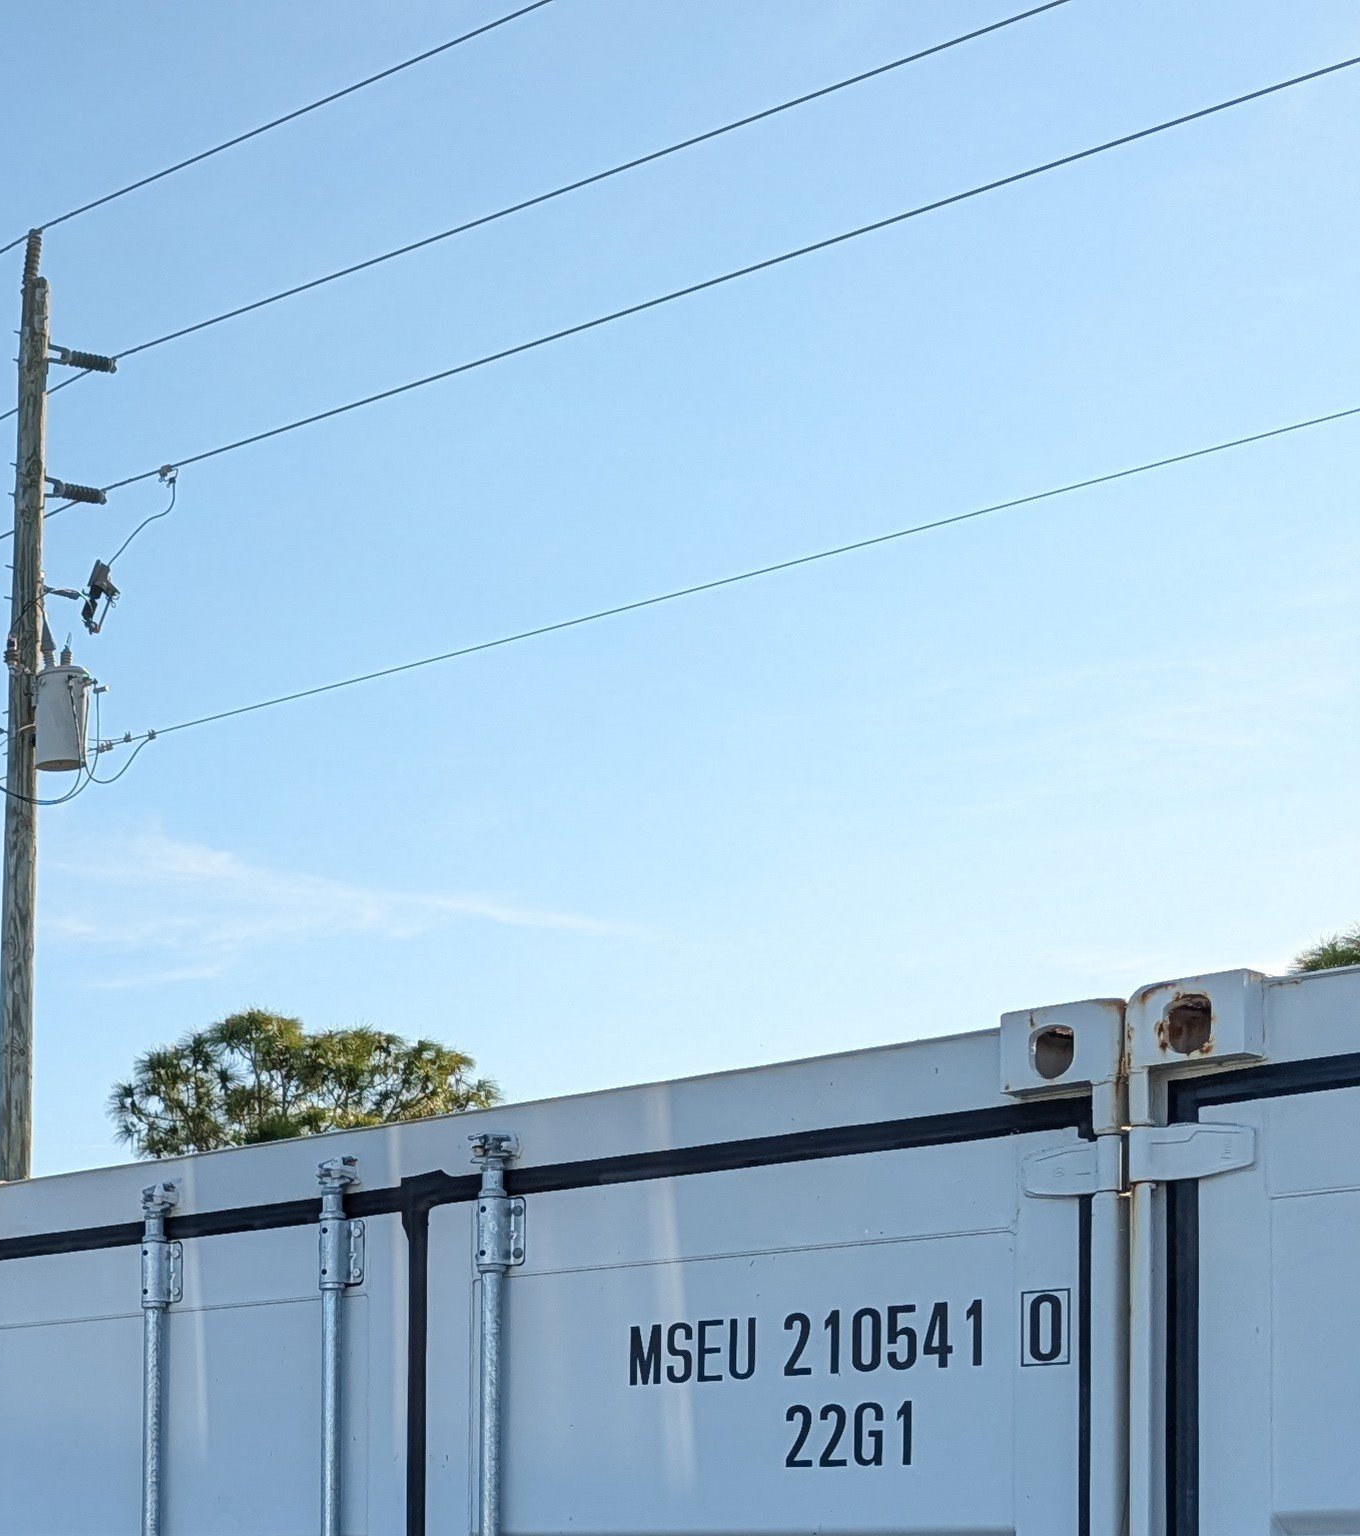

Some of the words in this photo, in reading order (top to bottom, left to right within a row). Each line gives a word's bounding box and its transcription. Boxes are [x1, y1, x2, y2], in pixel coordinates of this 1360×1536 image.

[629, 1317, 757, 1386] MSEU
[783, 1299, 984, 1377] 210541
[1029, 1294, 1062, 1362] 0
[785, 1401, 913, 1468] 22G1
